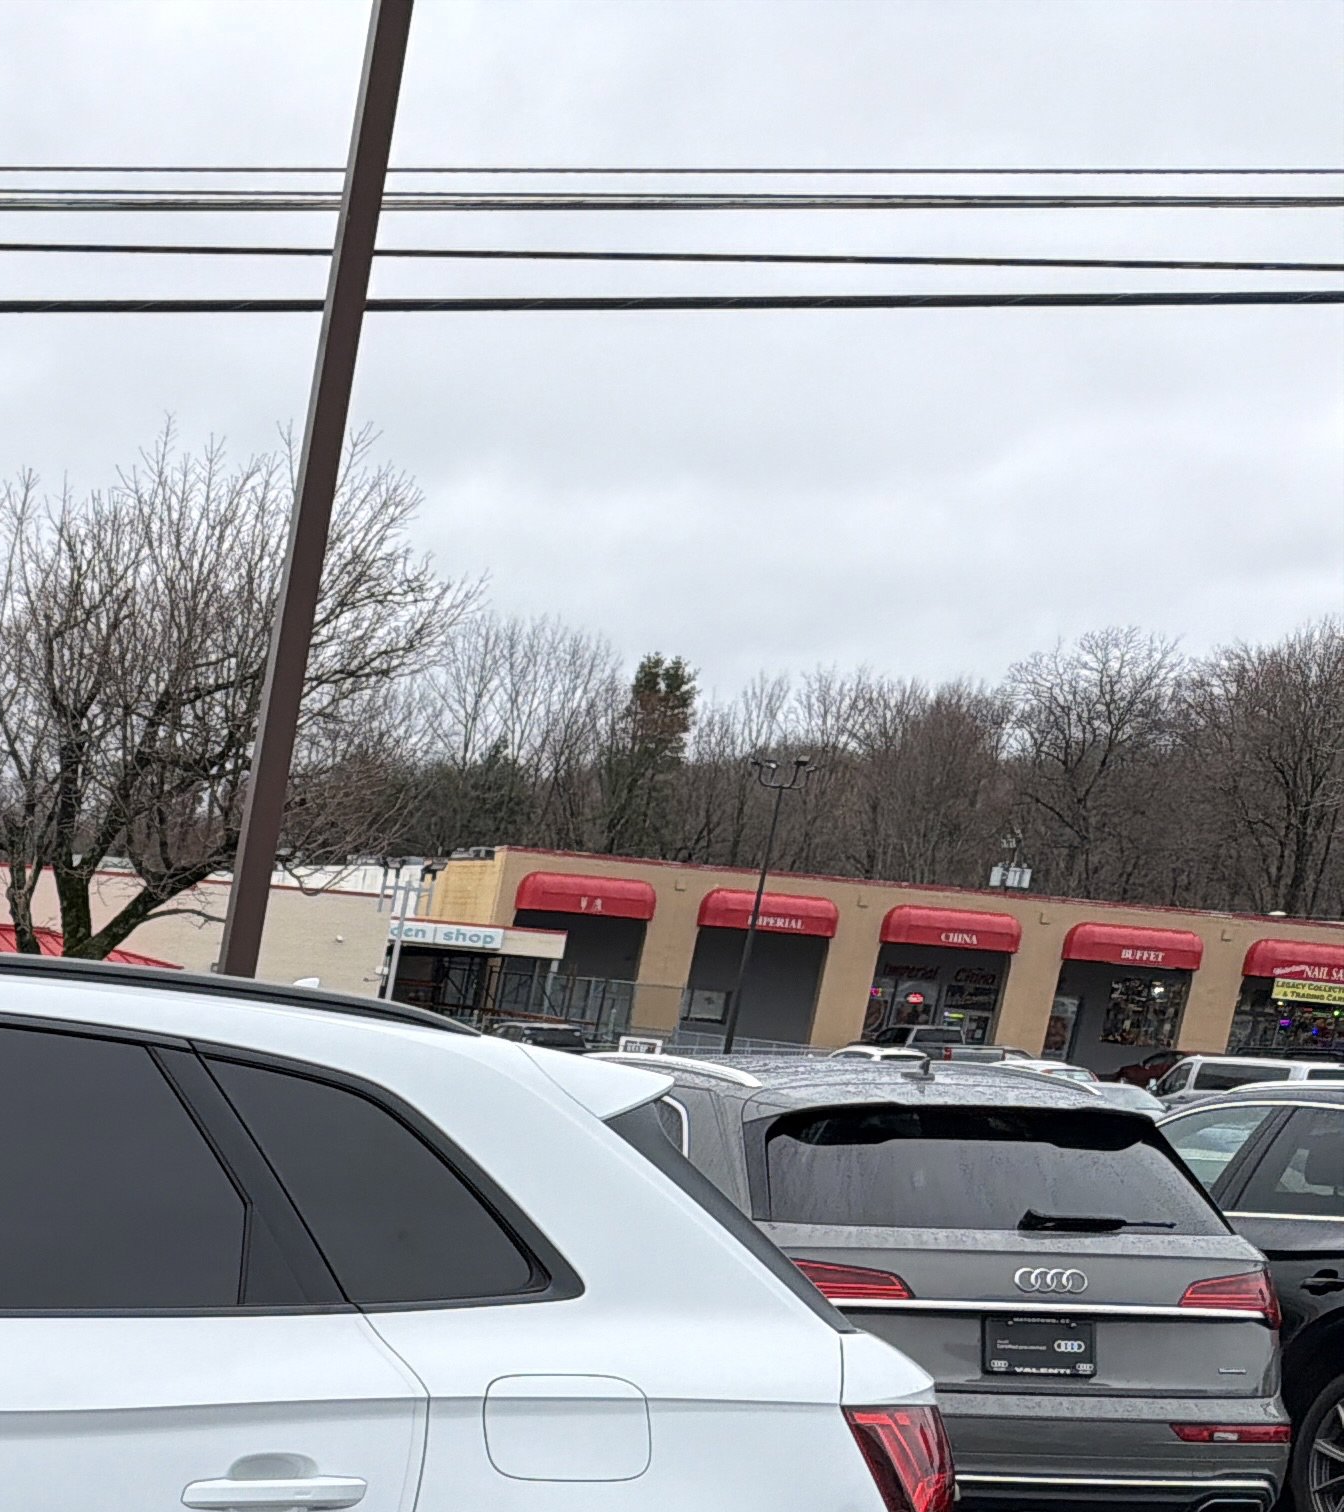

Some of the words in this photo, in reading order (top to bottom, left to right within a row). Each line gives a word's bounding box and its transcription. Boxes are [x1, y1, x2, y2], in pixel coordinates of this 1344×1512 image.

[442, 928, 496, 947] shop
[940, 932, 978, 945] CHINA
[1120, 949, 1166, 962] BUFFET
[1302, 965, 1330, 980] NAIL
